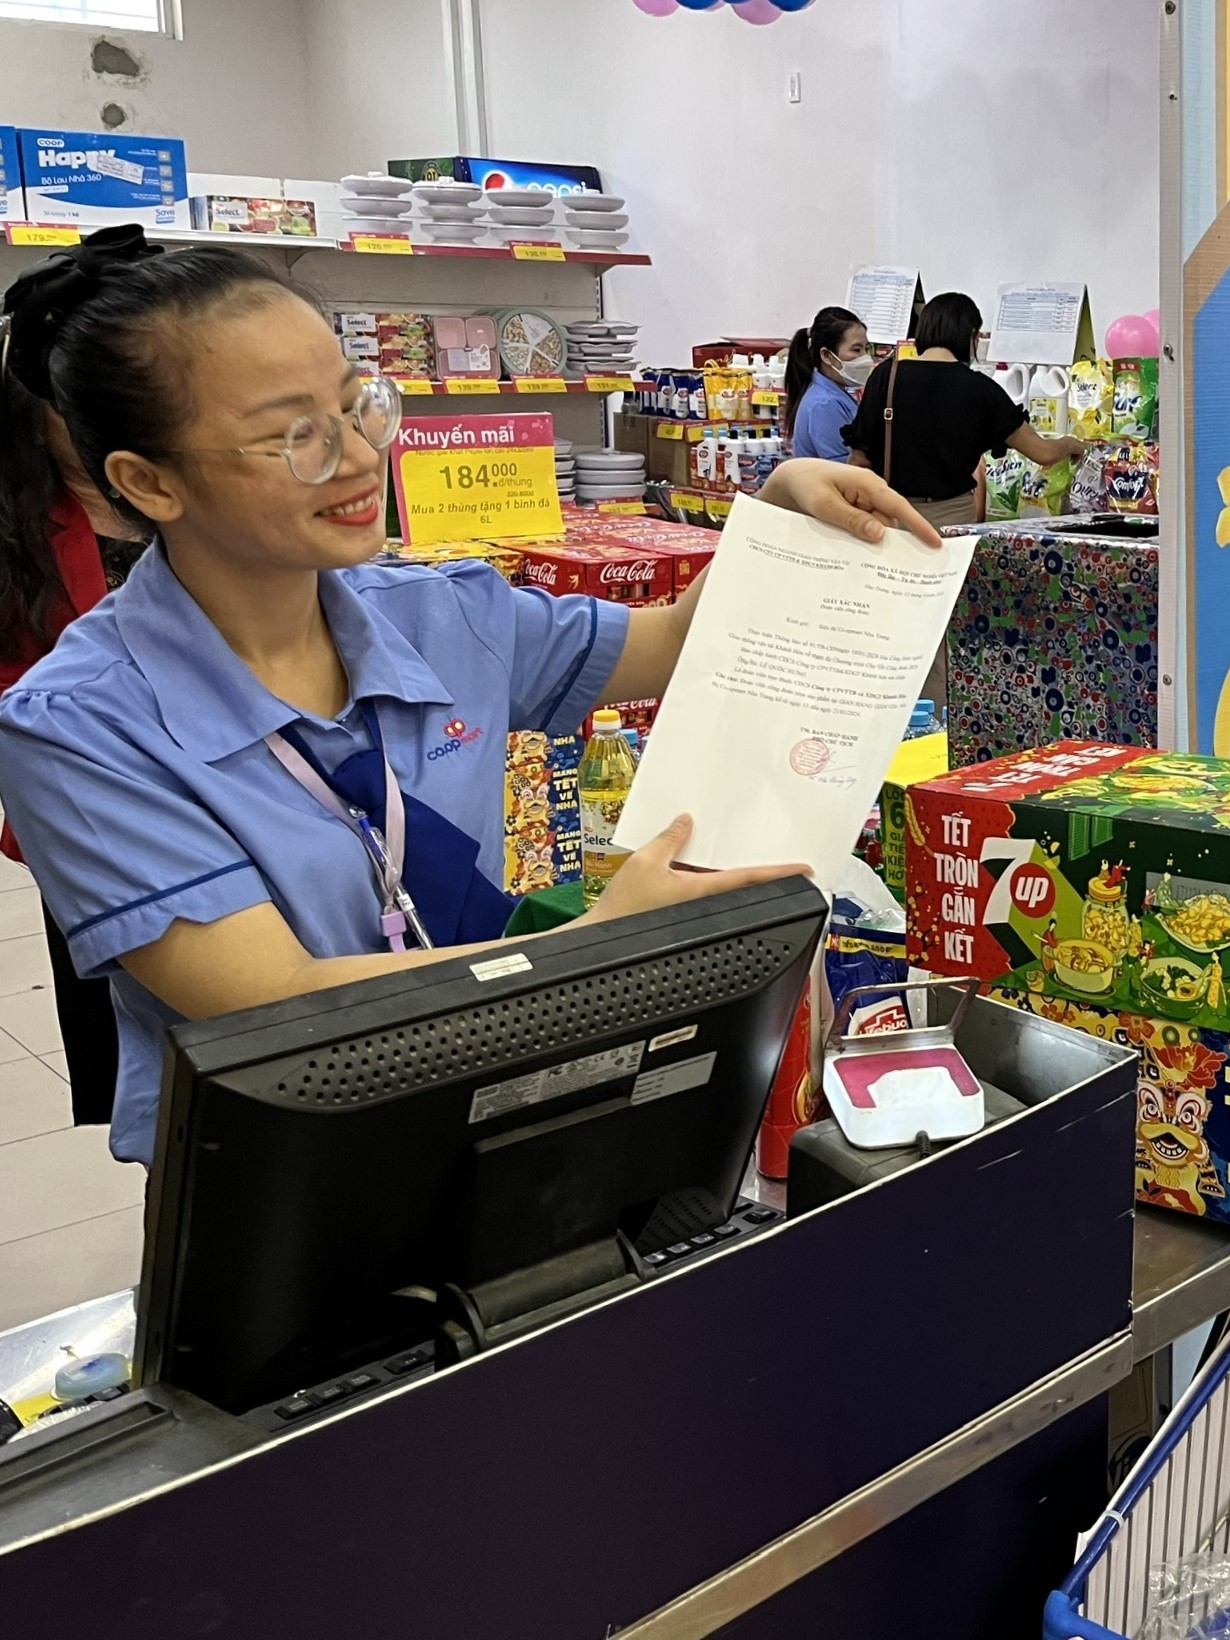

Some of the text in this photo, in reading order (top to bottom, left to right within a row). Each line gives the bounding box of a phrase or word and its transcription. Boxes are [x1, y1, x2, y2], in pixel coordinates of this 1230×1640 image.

[86, 174, 102, 182] 360
[215, 206, 240, 217] Select
[399, 424, 515, 449] Khuyến mãi
[411, 503, 435, 515] Mua
[438, 503, 445, 513] 2
[447, 502, 477, 514] thùng
[480, 501, 502, 513] tặng
[505, 501, 510, 510] 1
[480, 515, 493, 524] 6L
[941, 810, 972, 848] TẾT
[583, 832, 614, 847] Selec
[933, 851, 979, 889] TRÒN
[941, 887, 976, 927] GẮN
[944, 927, 974, 965] KẾT
